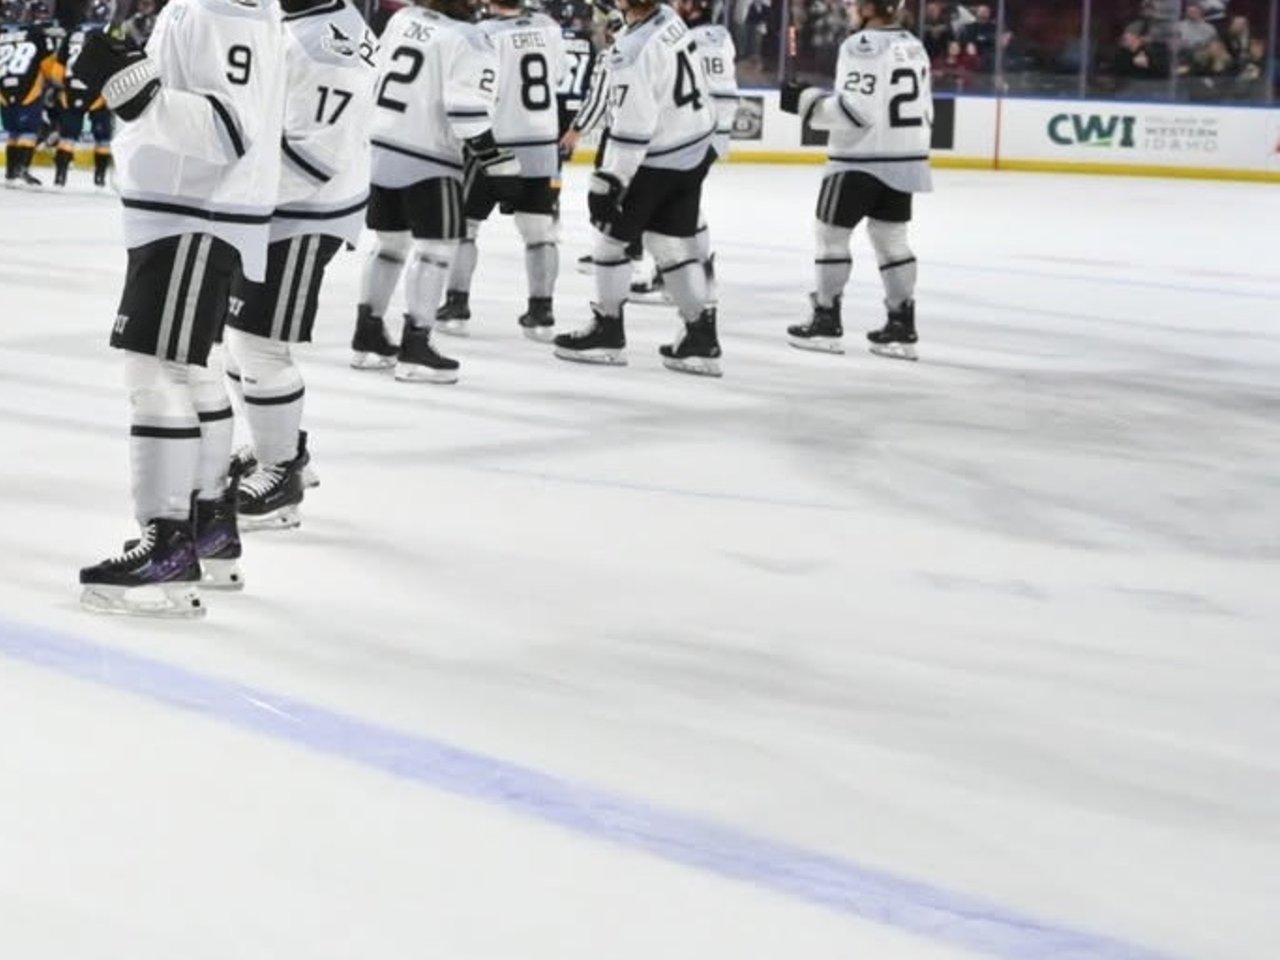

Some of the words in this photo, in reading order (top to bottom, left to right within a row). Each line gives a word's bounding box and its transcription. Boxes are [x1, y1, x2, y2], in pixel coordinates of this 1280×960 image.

[226, 44, 253, 86] 9
[376, 45, 426, 114] 2
[519, 52, 552, 112] 8
[844, 70, 878, 96] 23
[313, 85, 355, 126] 17
[888, 67, 930, 129] 2
[1046, 112, 1137, 149] CWI
[1144, 127, 1219, 138] WESTERN
[1144, 139, 1219, 153] IDAHO
